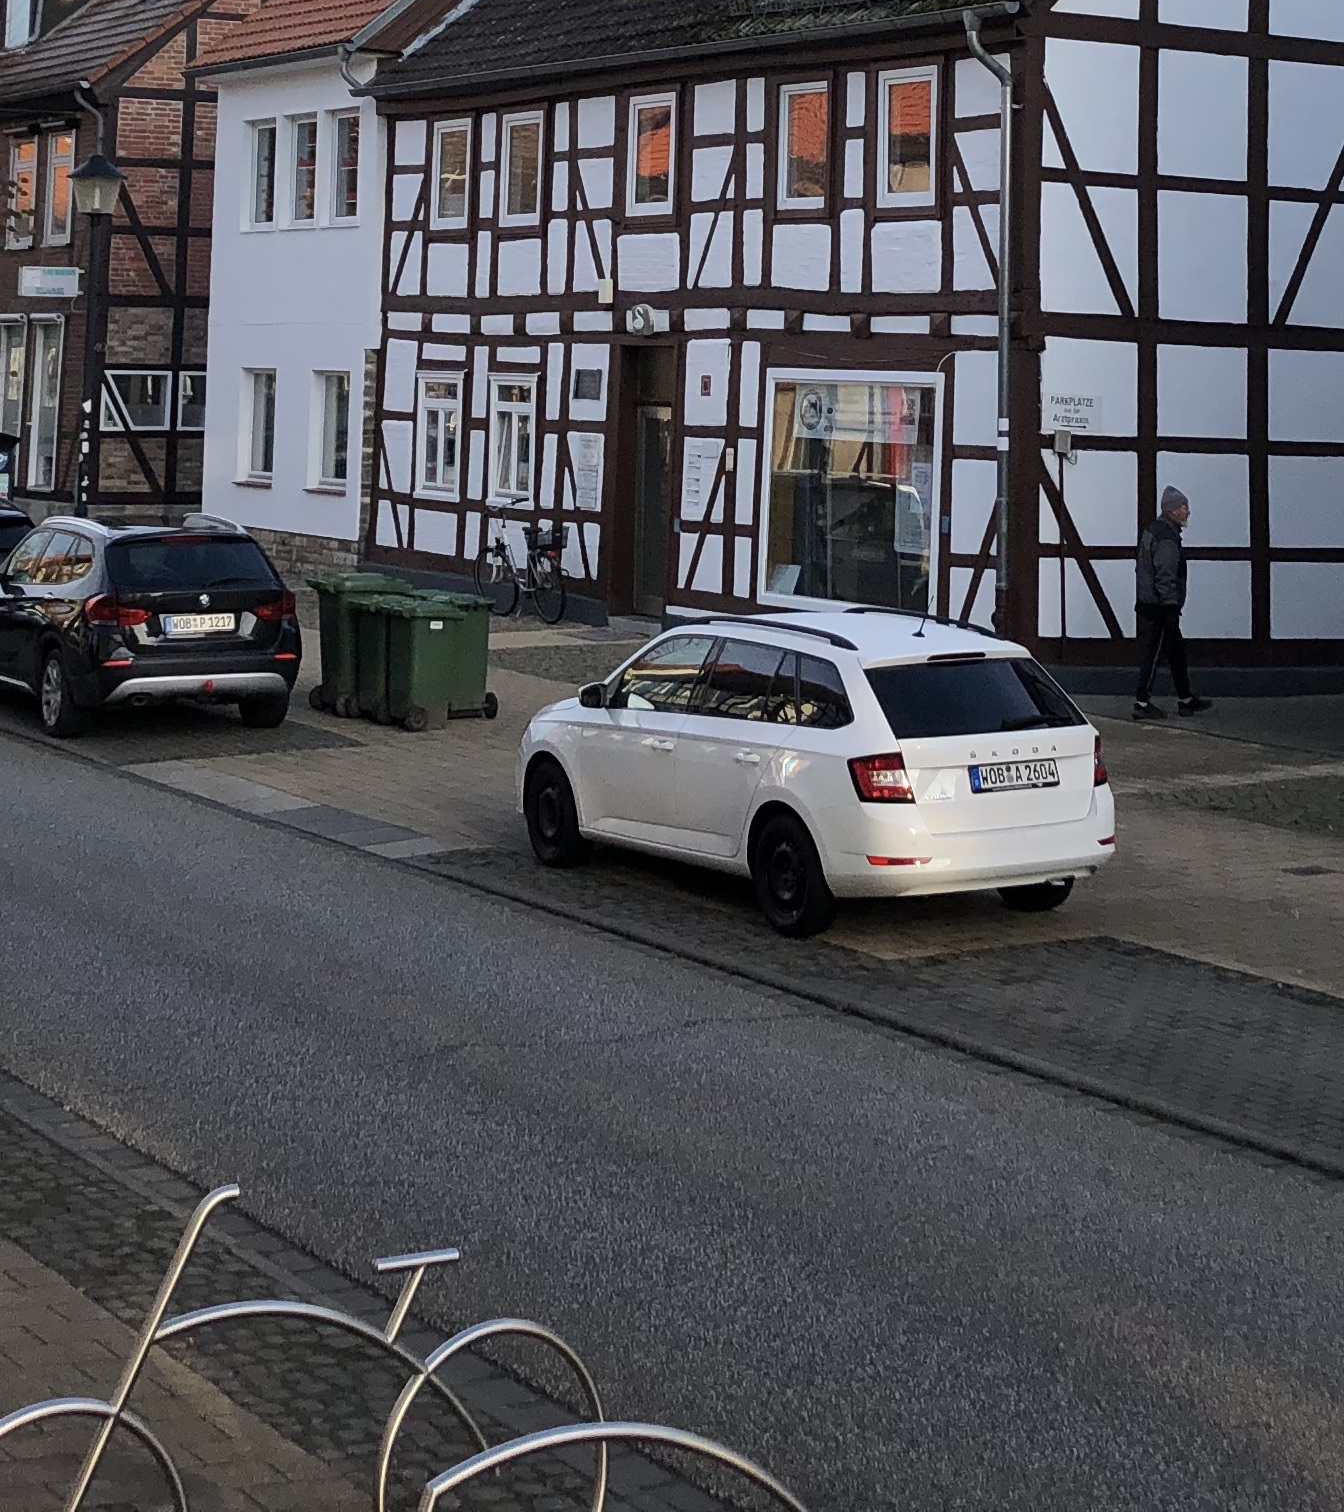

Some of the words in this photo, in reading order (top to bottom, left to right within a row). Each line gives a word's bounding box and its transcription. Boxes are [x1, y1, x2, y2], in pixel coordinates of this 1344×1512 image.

[172, 617, 192, 630] WOB
[200, 617, 206, 628] P
[208, 616, 233, 628] 1217
[980, 767, 1005, 786] WOB
[1015, 765, 1023, 782] A
[1026, 763, 1056, 782] 2604
